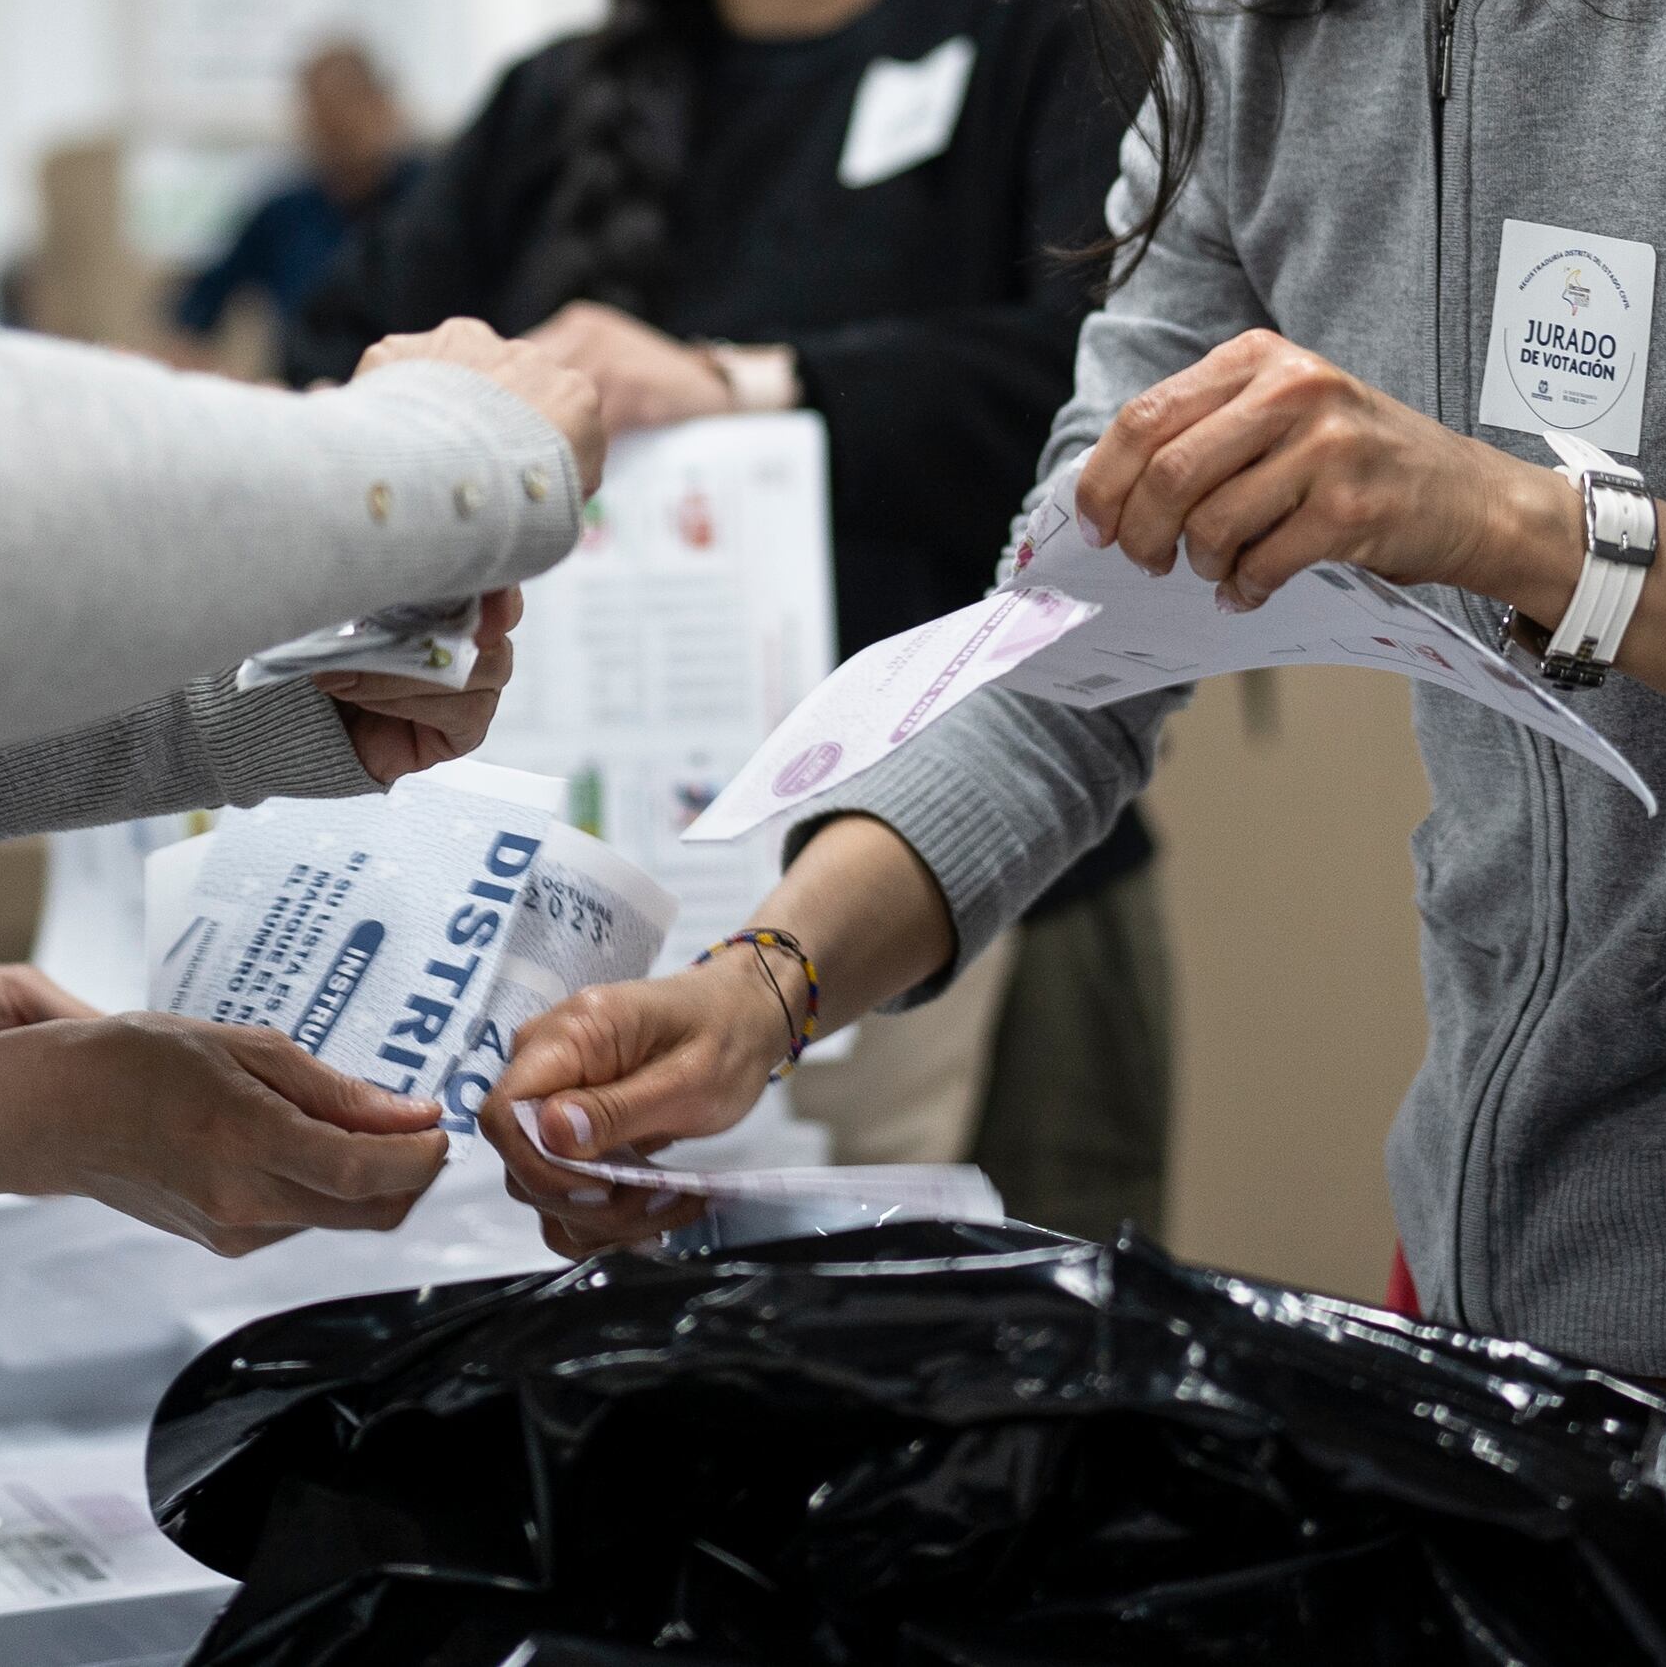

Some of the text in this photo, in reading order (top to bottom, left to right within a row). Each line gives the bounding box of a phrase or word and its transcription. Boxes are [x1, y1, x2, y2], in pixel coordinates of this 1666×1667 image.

[1524, 320, 1616, 359] JURADO
[1520, 348, 1615, 381] DE VOTACIÓN
[899, 693, 935, 734] VOTO
[285, 862, 311, 888] EL
[266, 870, 331, 964] MARQUE
[541, 875, 613, 926] OCTUBRE
[264, 850, 371, 1012] SI SU LISTA ES
[249, 969, 274, 995] EL
